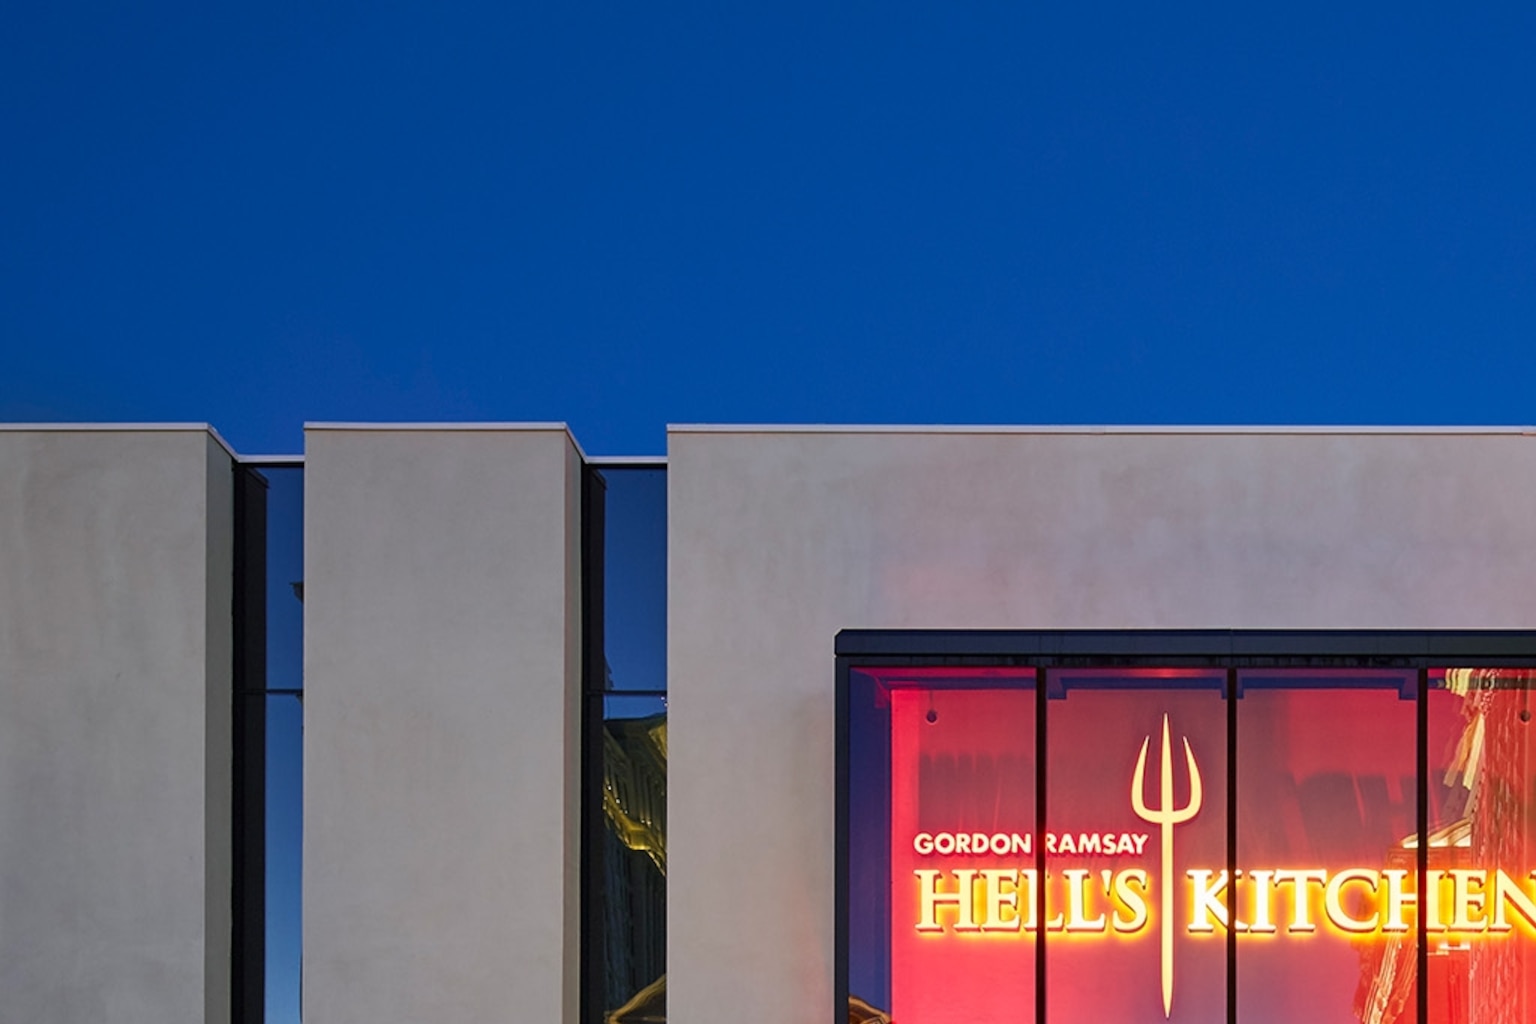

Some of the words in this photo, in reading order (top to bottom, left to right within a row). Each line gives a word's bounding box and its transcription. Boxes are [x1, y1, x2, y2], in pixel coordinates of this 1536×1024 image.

[914, 833, 1031, 854] GORDON
[1045, 833, 1148, 854] RAMSAY
[914, 869, 1148, 932] HELL'S
